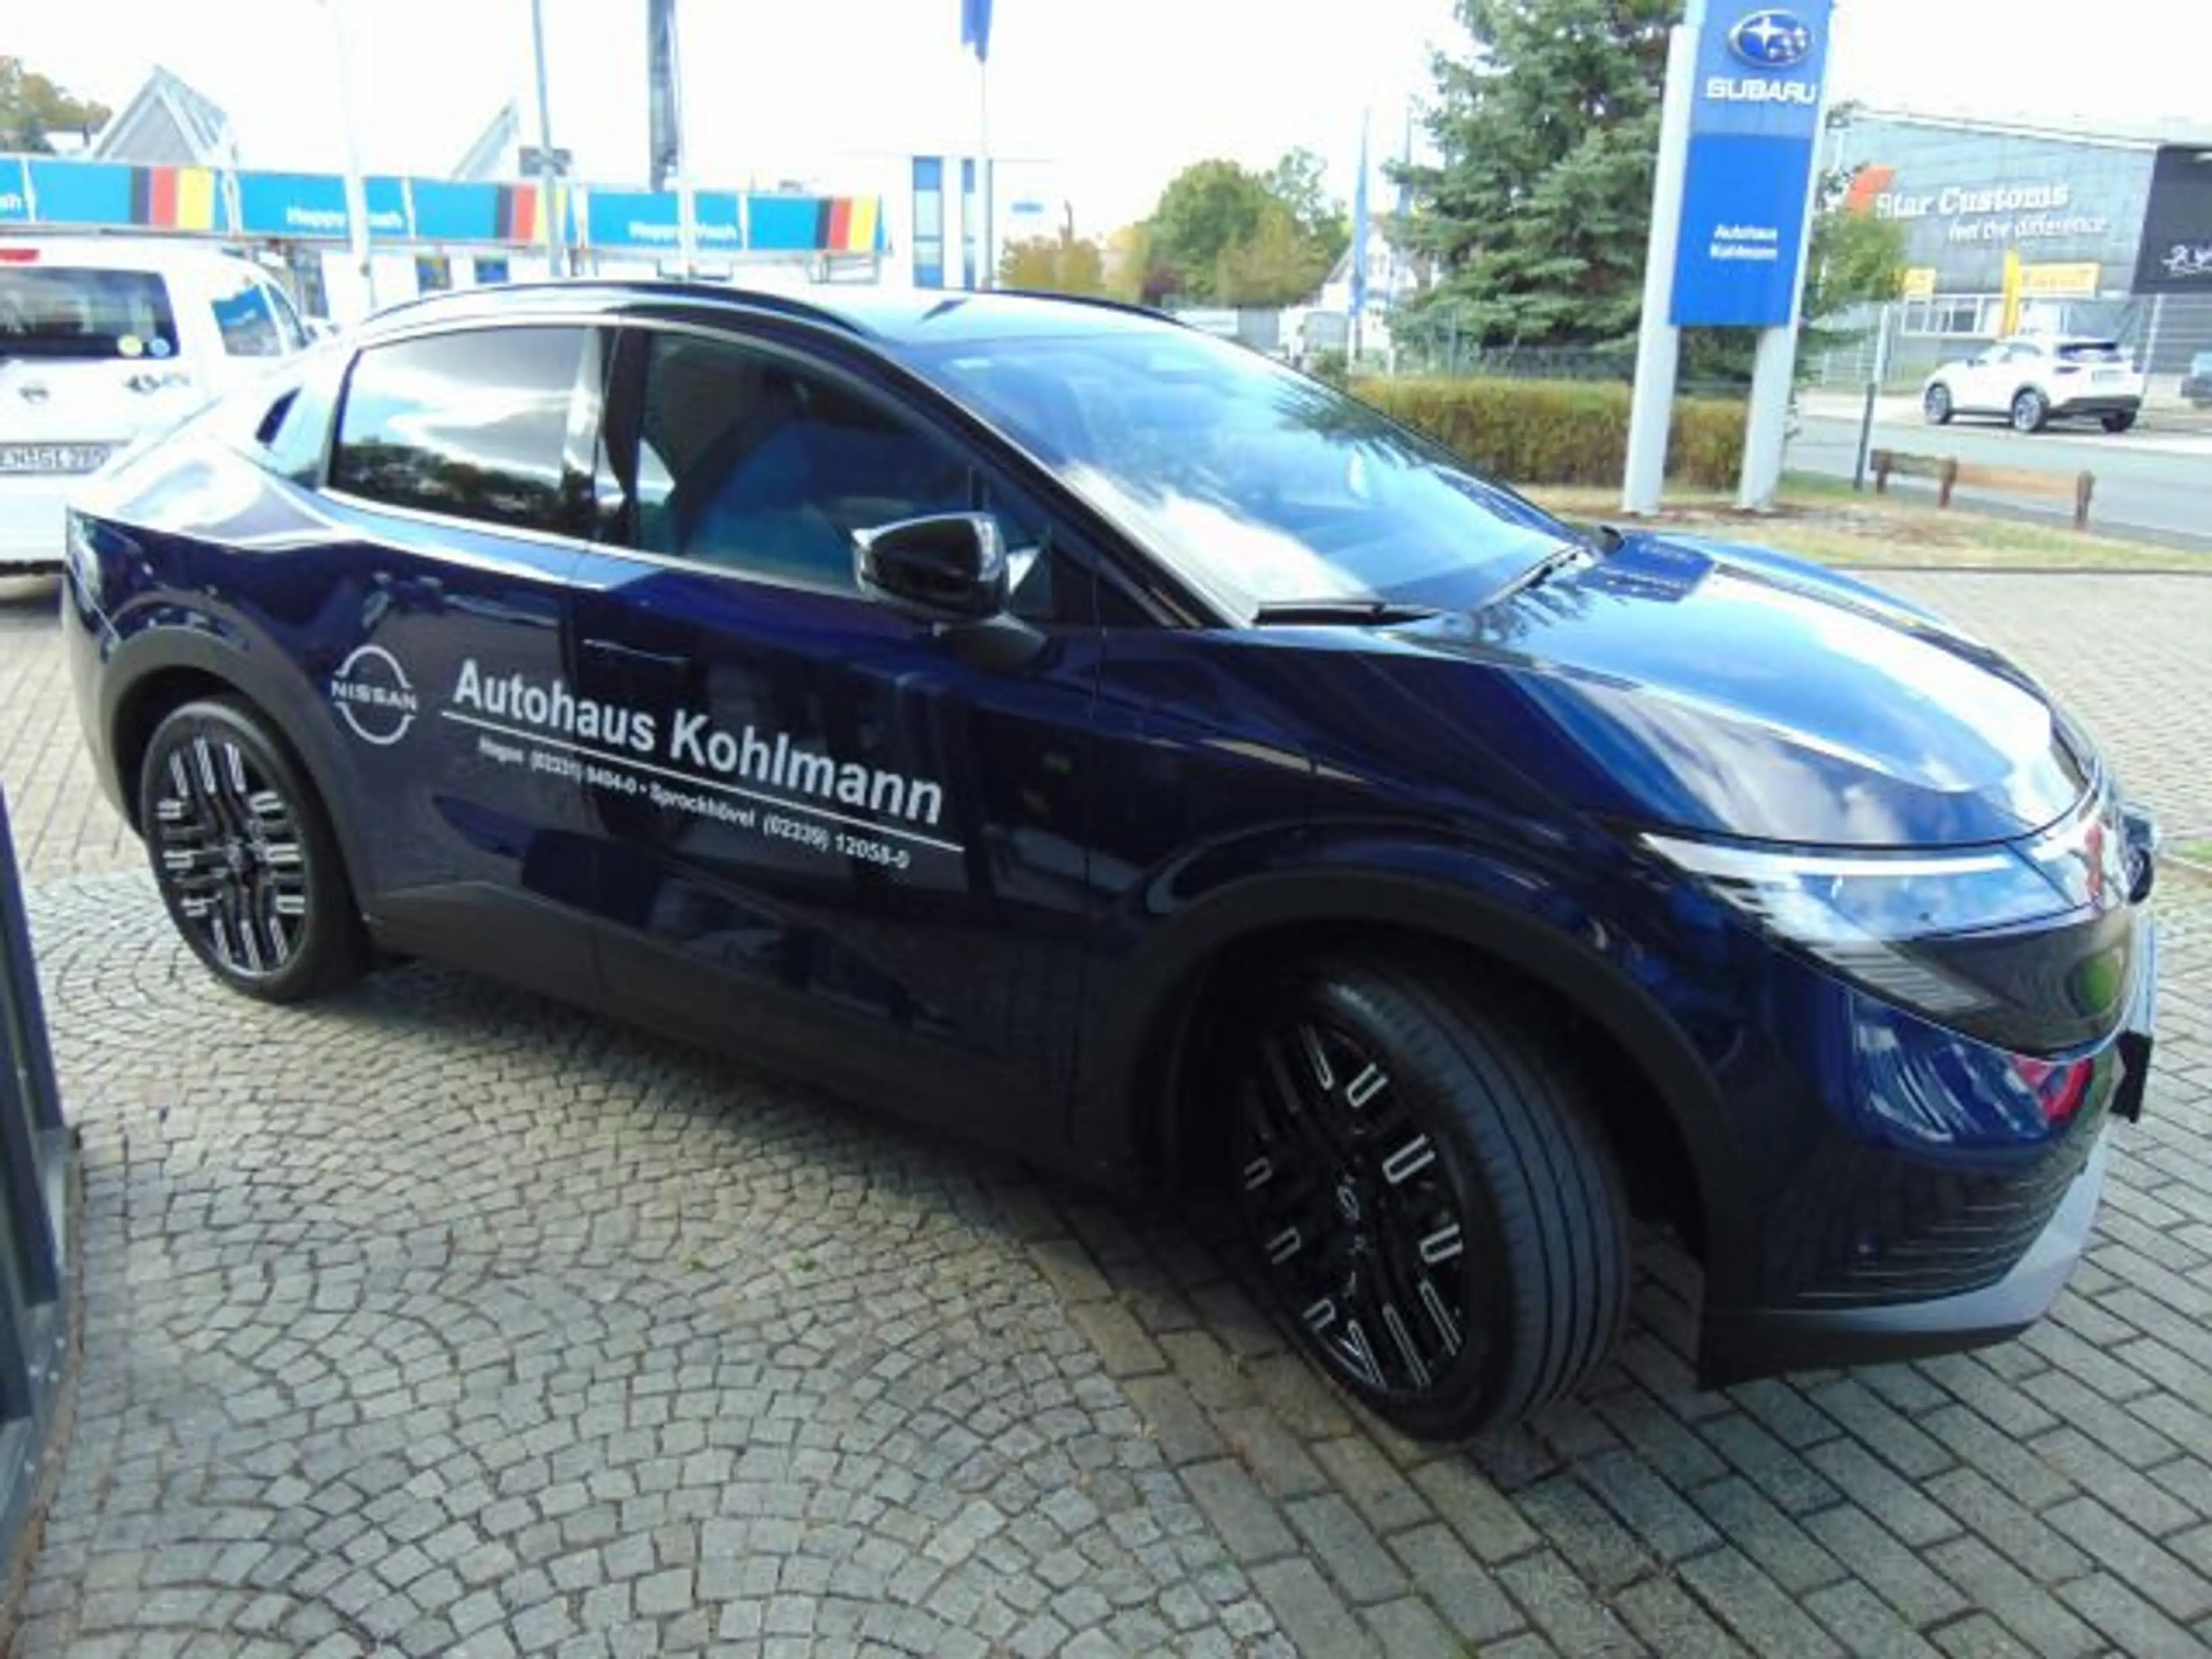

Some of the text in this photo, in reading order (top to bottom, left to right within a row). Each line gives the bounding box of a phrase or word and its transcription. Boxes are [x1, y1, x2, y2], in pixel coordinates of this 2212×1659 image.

[1706, 77, 1816, 105] SUBARU
[1938, 181, 2069, 217] Customs
[330, 679, 417, 711] NISSAN
[452, 658, 942, 825] Autohaus Kohlmann
